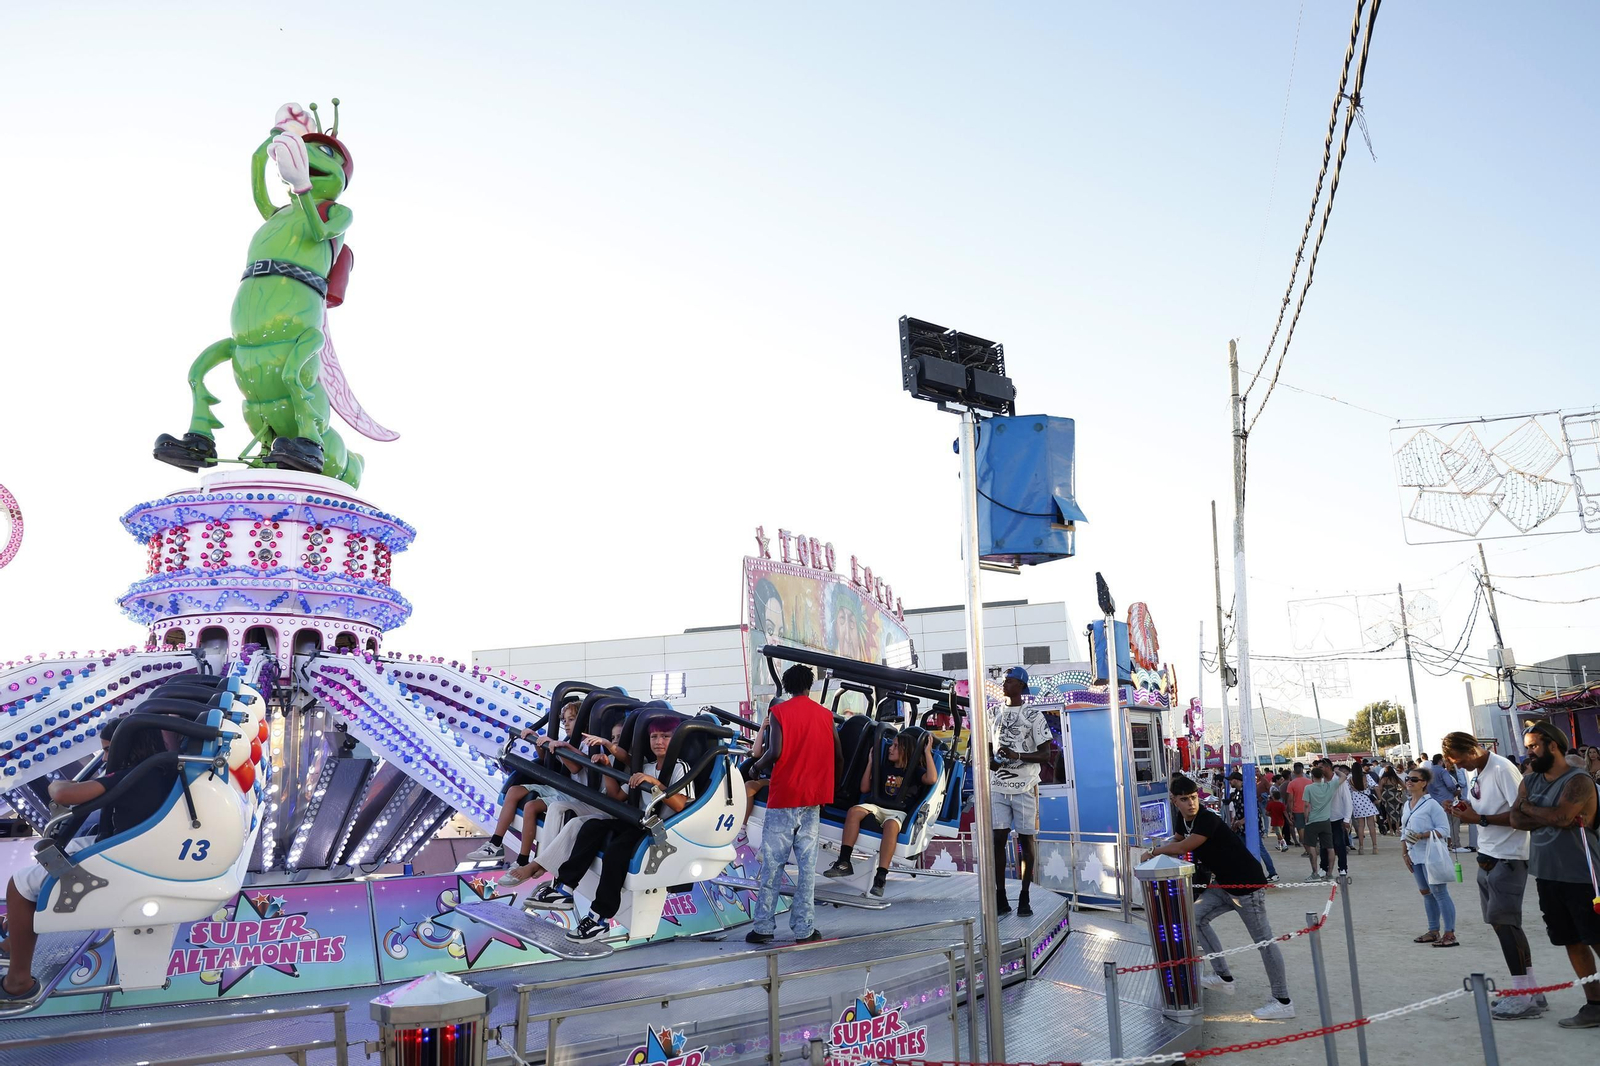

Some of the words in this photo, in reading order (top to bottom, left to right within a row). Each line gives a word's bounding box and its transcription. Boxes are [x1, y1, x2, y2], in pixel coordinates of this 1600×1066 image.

[778, 528, 836, 572] TORO
[851, 555, 893, 610] LOCO
[715, 813, 735, 832] 14
[178, 838, 211, 862] 13
[190, 915, 310, 944] SUPER
[167, 937, 346, 976] ALTAMONTES
[833, 1011, 904, 1046] SUPER
